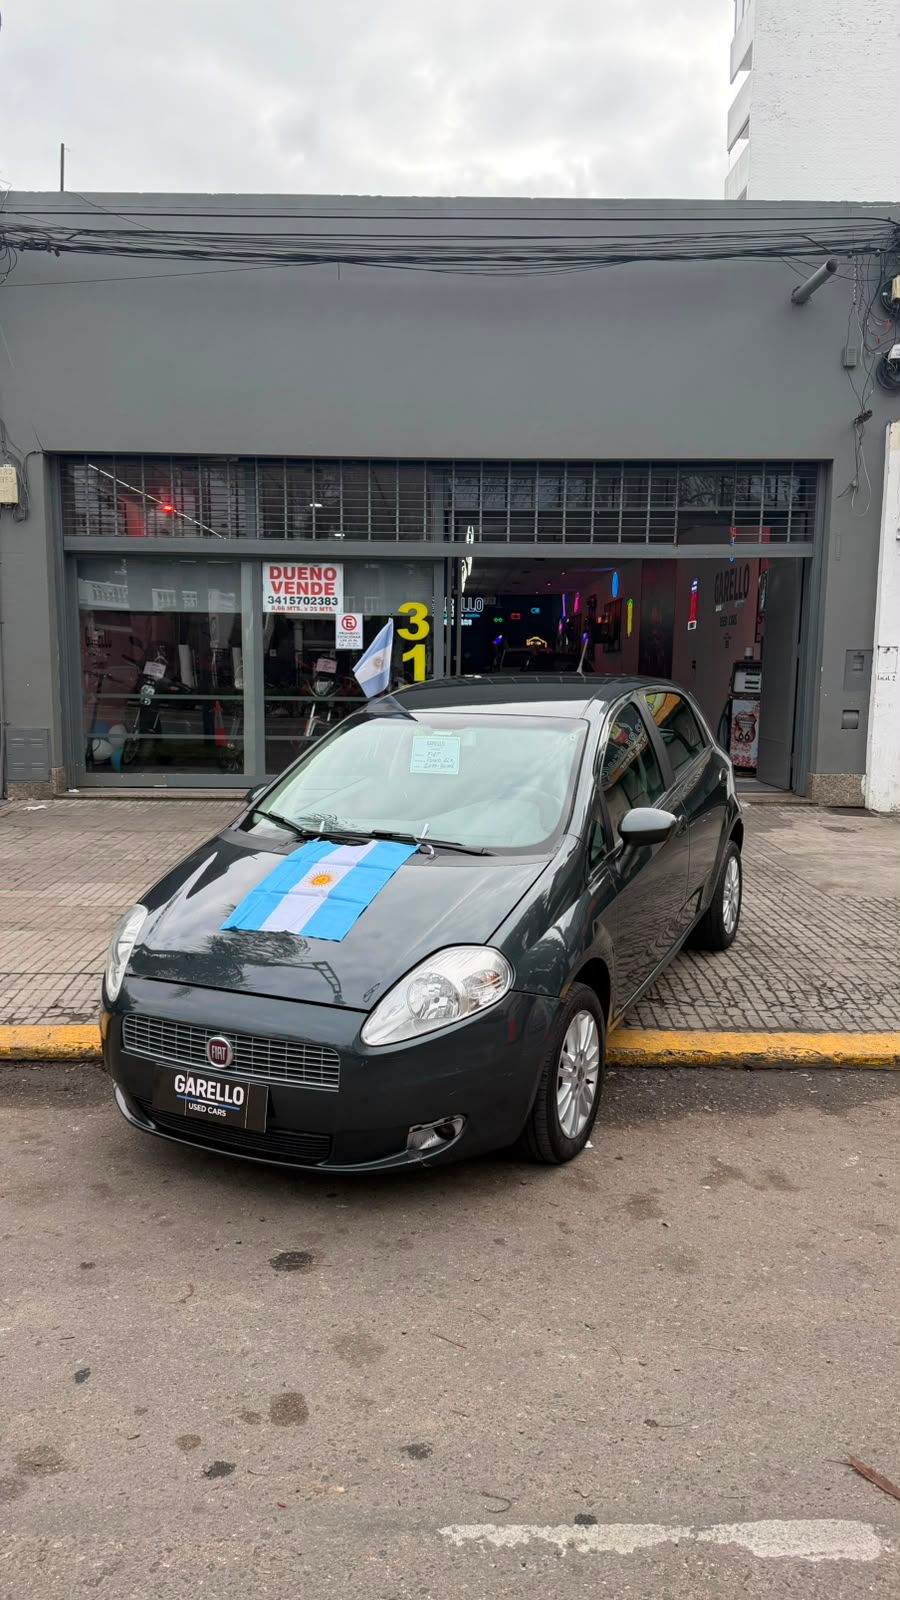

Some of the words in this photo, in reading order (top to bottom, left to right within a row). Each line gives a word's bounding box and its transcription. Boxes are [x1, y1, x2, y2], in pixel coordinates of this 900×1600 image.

[269, 564, 337, 581] DUEÑO
[271, 581, 335, 596] VENDE
[714, 564, 750, 604] GARELLO
[267, 595, 338, 606] 3415702383
[211, 1045, 226, 1061] FIAT
[174, 1074, 245, 1105] GARELLO
[188, 1102, 207, 1113] USED
[207, 1106, 227, 1117] CARS
